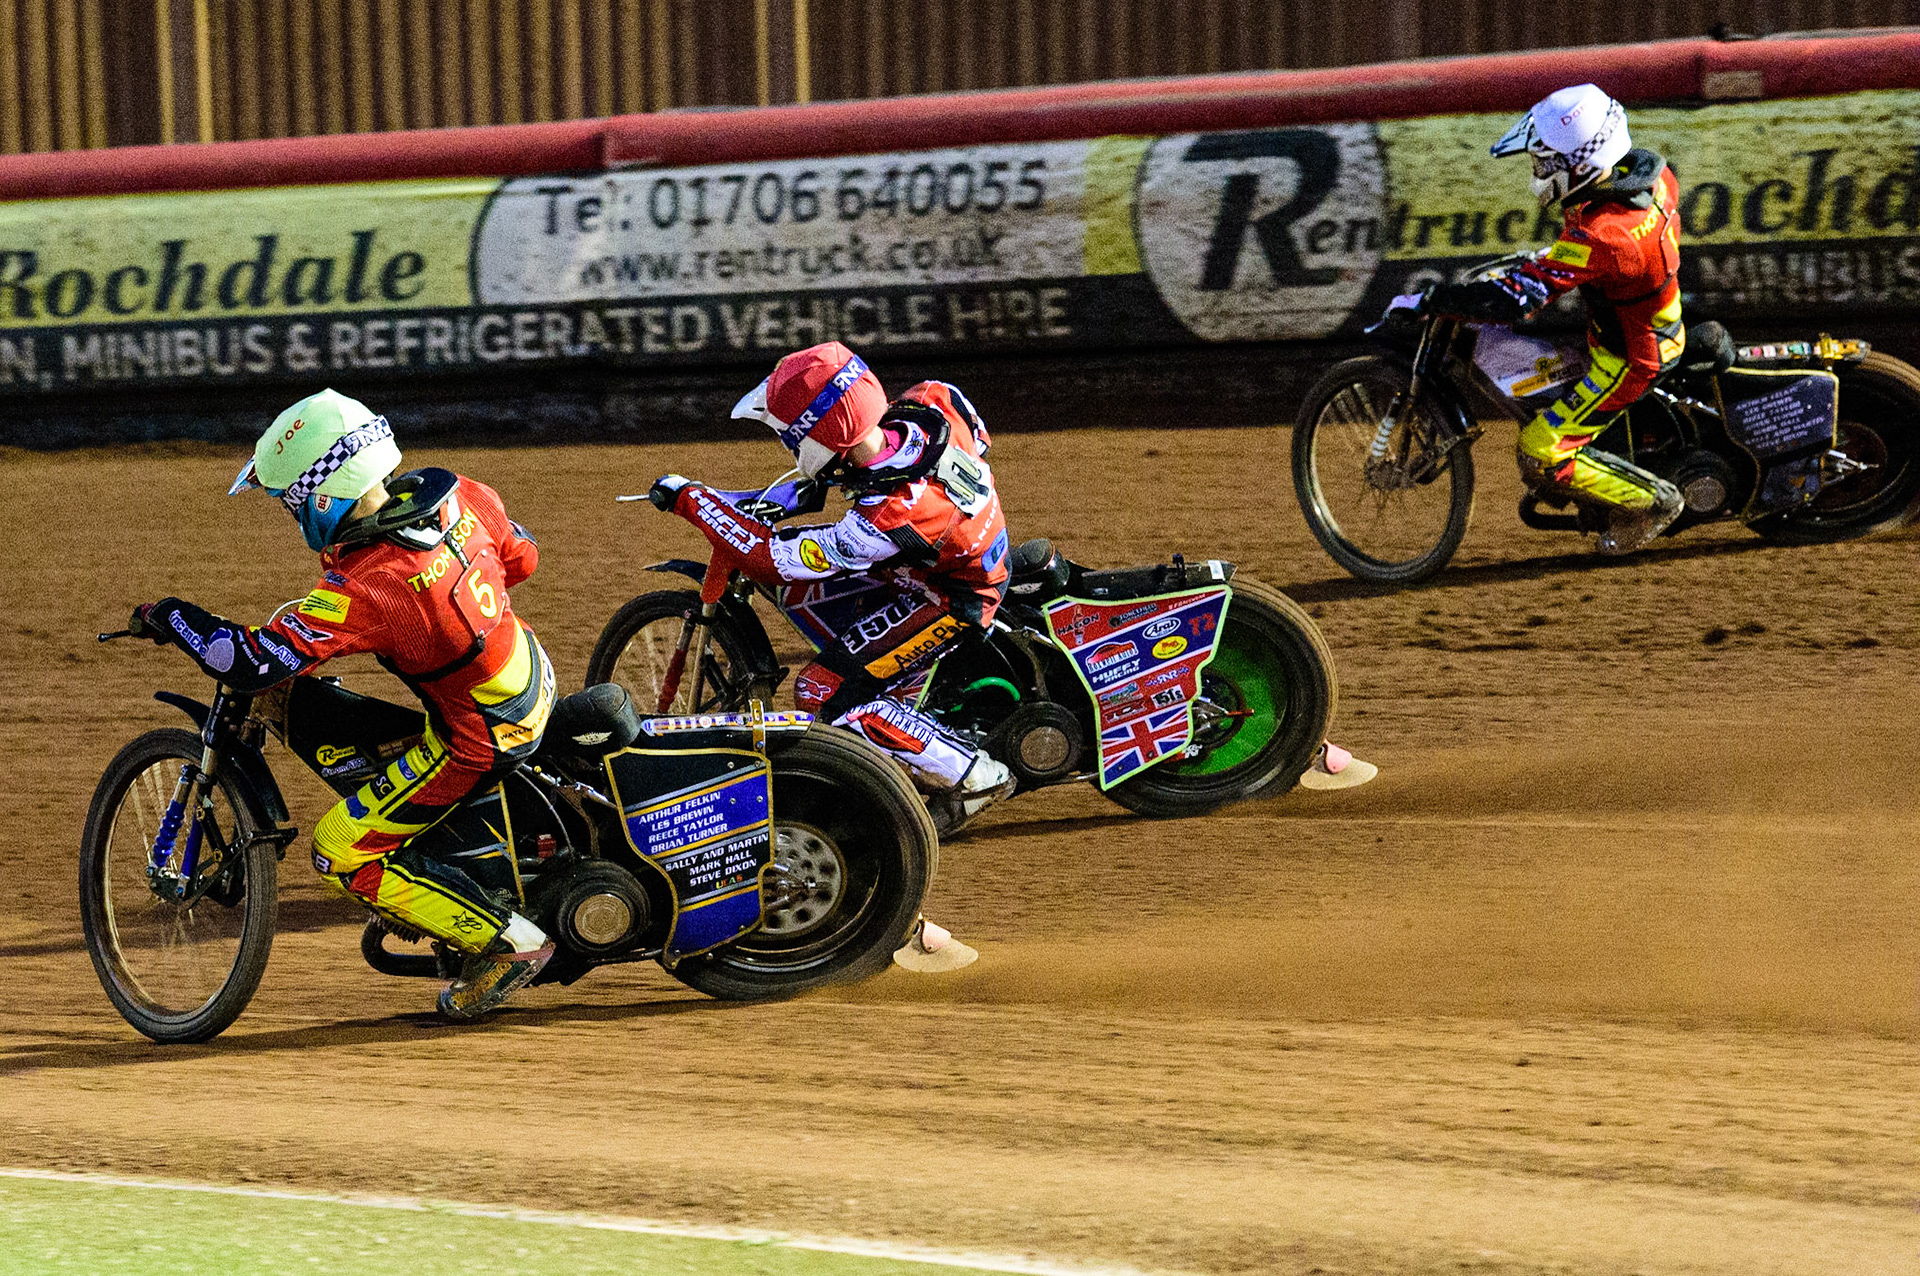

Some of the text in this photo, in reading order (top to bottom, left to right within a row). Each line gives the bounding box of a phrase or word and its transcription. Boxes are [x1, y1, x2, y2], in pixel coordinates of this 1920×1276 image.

[647, 170, 823, 229] 01706
[835, 159, 1046, 222] 640055
[1679, 145, 1920, 238] ochd
[579, 228, 1000, 285] www.rentruck.co.uk
[0, 230, 427, 320] Rochdale
[63, 324, 272, 382] MINIBUS
[285, 323, 321, 372] &
[331, 304, 706, 370] REFRIGERATED
[713, 295, 940, 351] VEHICLE
[275, 418, 305, 455] Joe
[688, 489, 764, 546] HUFFY
[407, 507, 478, 592] THOMSON
[468, 569, 498, 619] 5
[1056, 612, 1101, 637] HAGON
[1147, 618, 1175, 638] Arai
[894, 640, 935, 670] Auto
[1092, 658, 1140, 683] HUFFY
[1152, 688, 1183, 705] 151s
[638, 791, 721, 825] ARTHUR FELKIN
[652, 805, 714, 832] LES BREWIN
[648, 813, 724, 844] REECE TAYLOR
[650, 823, 728, 855] BRIAN TURNER
[665, 833, 769, 872] SALLY AND MARTIN
[689, 850, 752, 876] MARK HALL
[689, 859, 757, 887] STEVE DIXON
